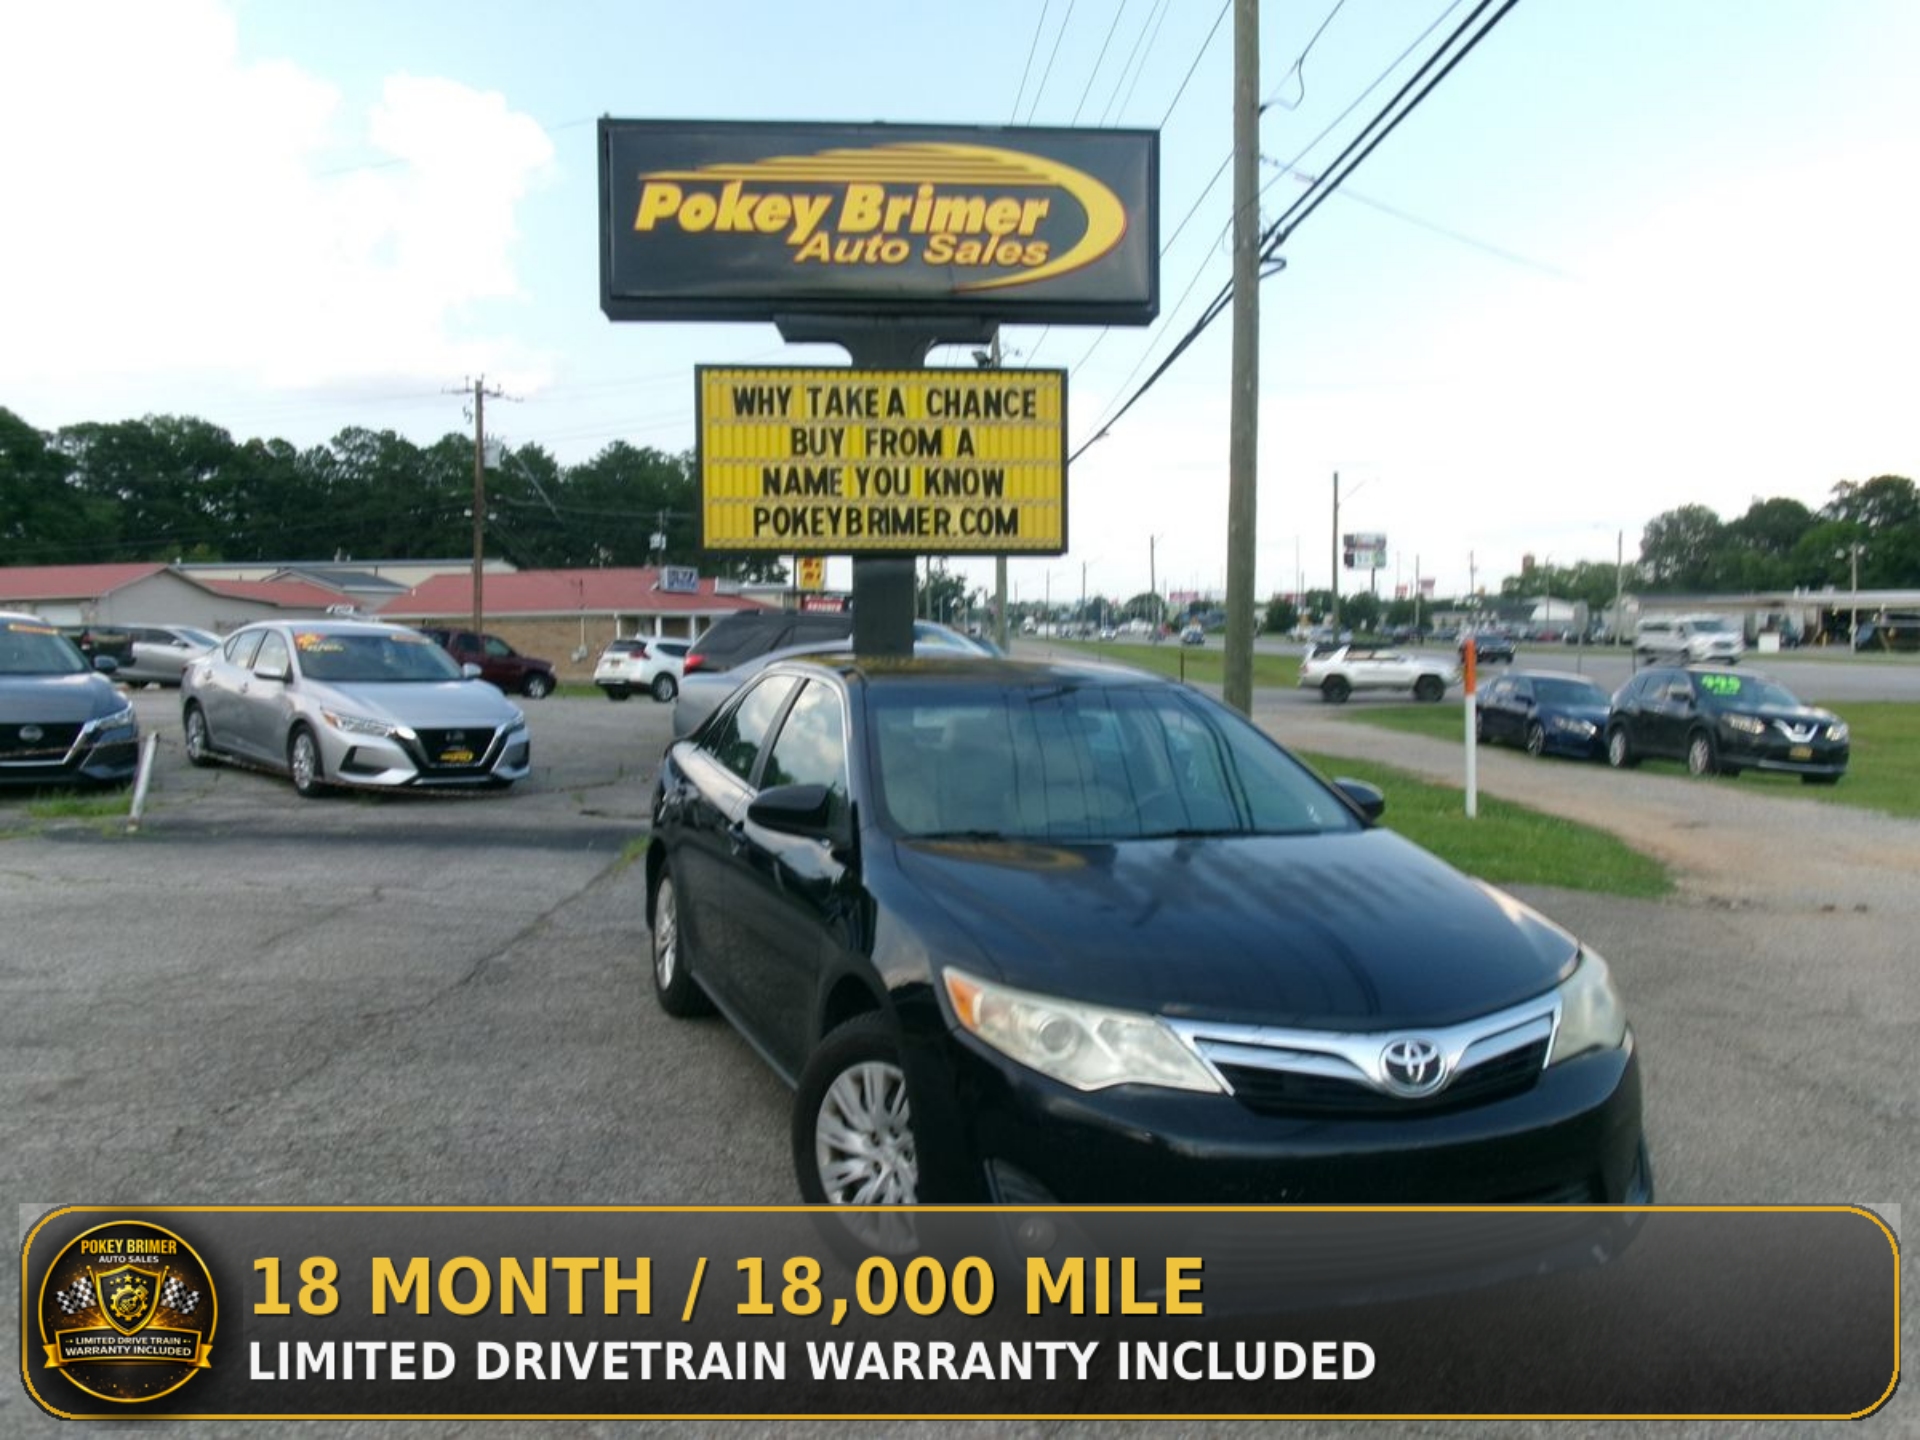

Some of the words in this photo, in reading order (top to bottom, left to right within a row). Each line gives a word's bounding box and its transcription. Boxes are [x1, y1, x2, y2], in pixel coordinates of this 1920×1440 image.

[634, 180, 832, 244] Pokey
[838, 180, 1050, 237] Brimer
[795, 231, 910, 265] Auto
[923, 232, 1050, 267] Sales
[732, 386, 792, 416] WHY
[806, 387, 879, 417] TAKE
[887, 388, 906, 417] A
[926, 388, 1037, 418] CHANCE
[791, 427, 845, 456] BUY
[865, 428, 943, 456] FROM
[956, 428, 975, 456] A
[762, 468, 843, 497] NAME
[855, 468, 911, 497] YOU
[924, 468, 1004, 497] KNOW
[753, 507, 1019, 538] POKEYBRIMER.COM
